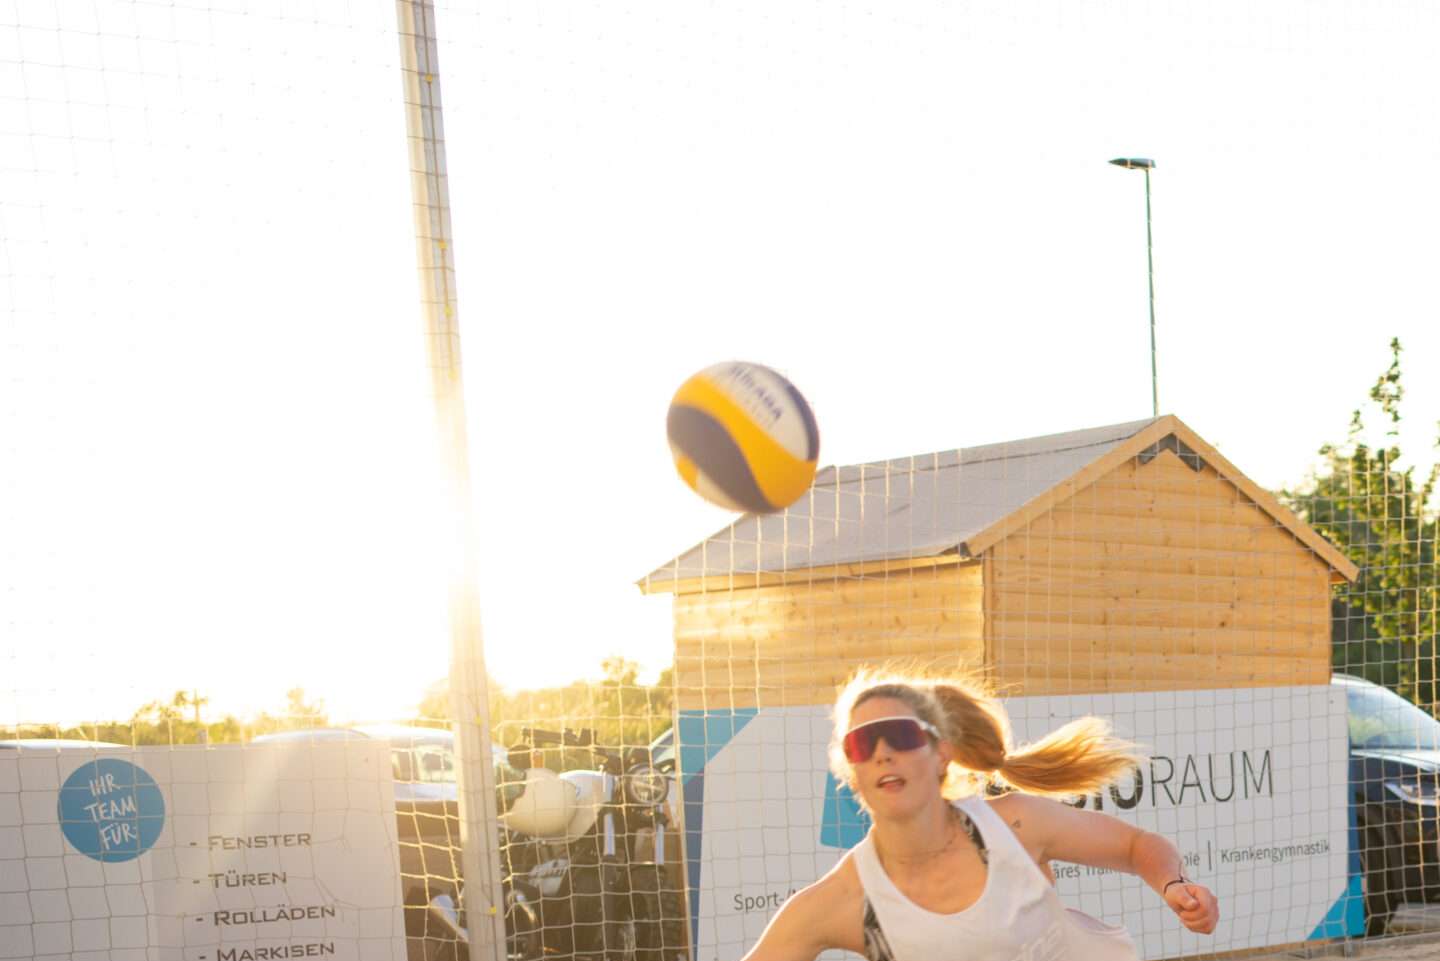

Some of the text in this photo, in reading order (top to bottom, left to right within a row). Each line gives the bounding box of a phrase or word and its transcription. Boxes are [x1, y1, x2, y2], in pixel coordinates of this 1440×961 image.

[89, 773, 120, 797] IHR
[83, 795, 136, 823] TEAM
[208, 832, 312, 852] FENSTER
[1221, 840, 1330, 863] Krankengymnastik
[209, 869, 287, 889] TÜREN
[213, 903, 336, 927] ROLLÄDEN
